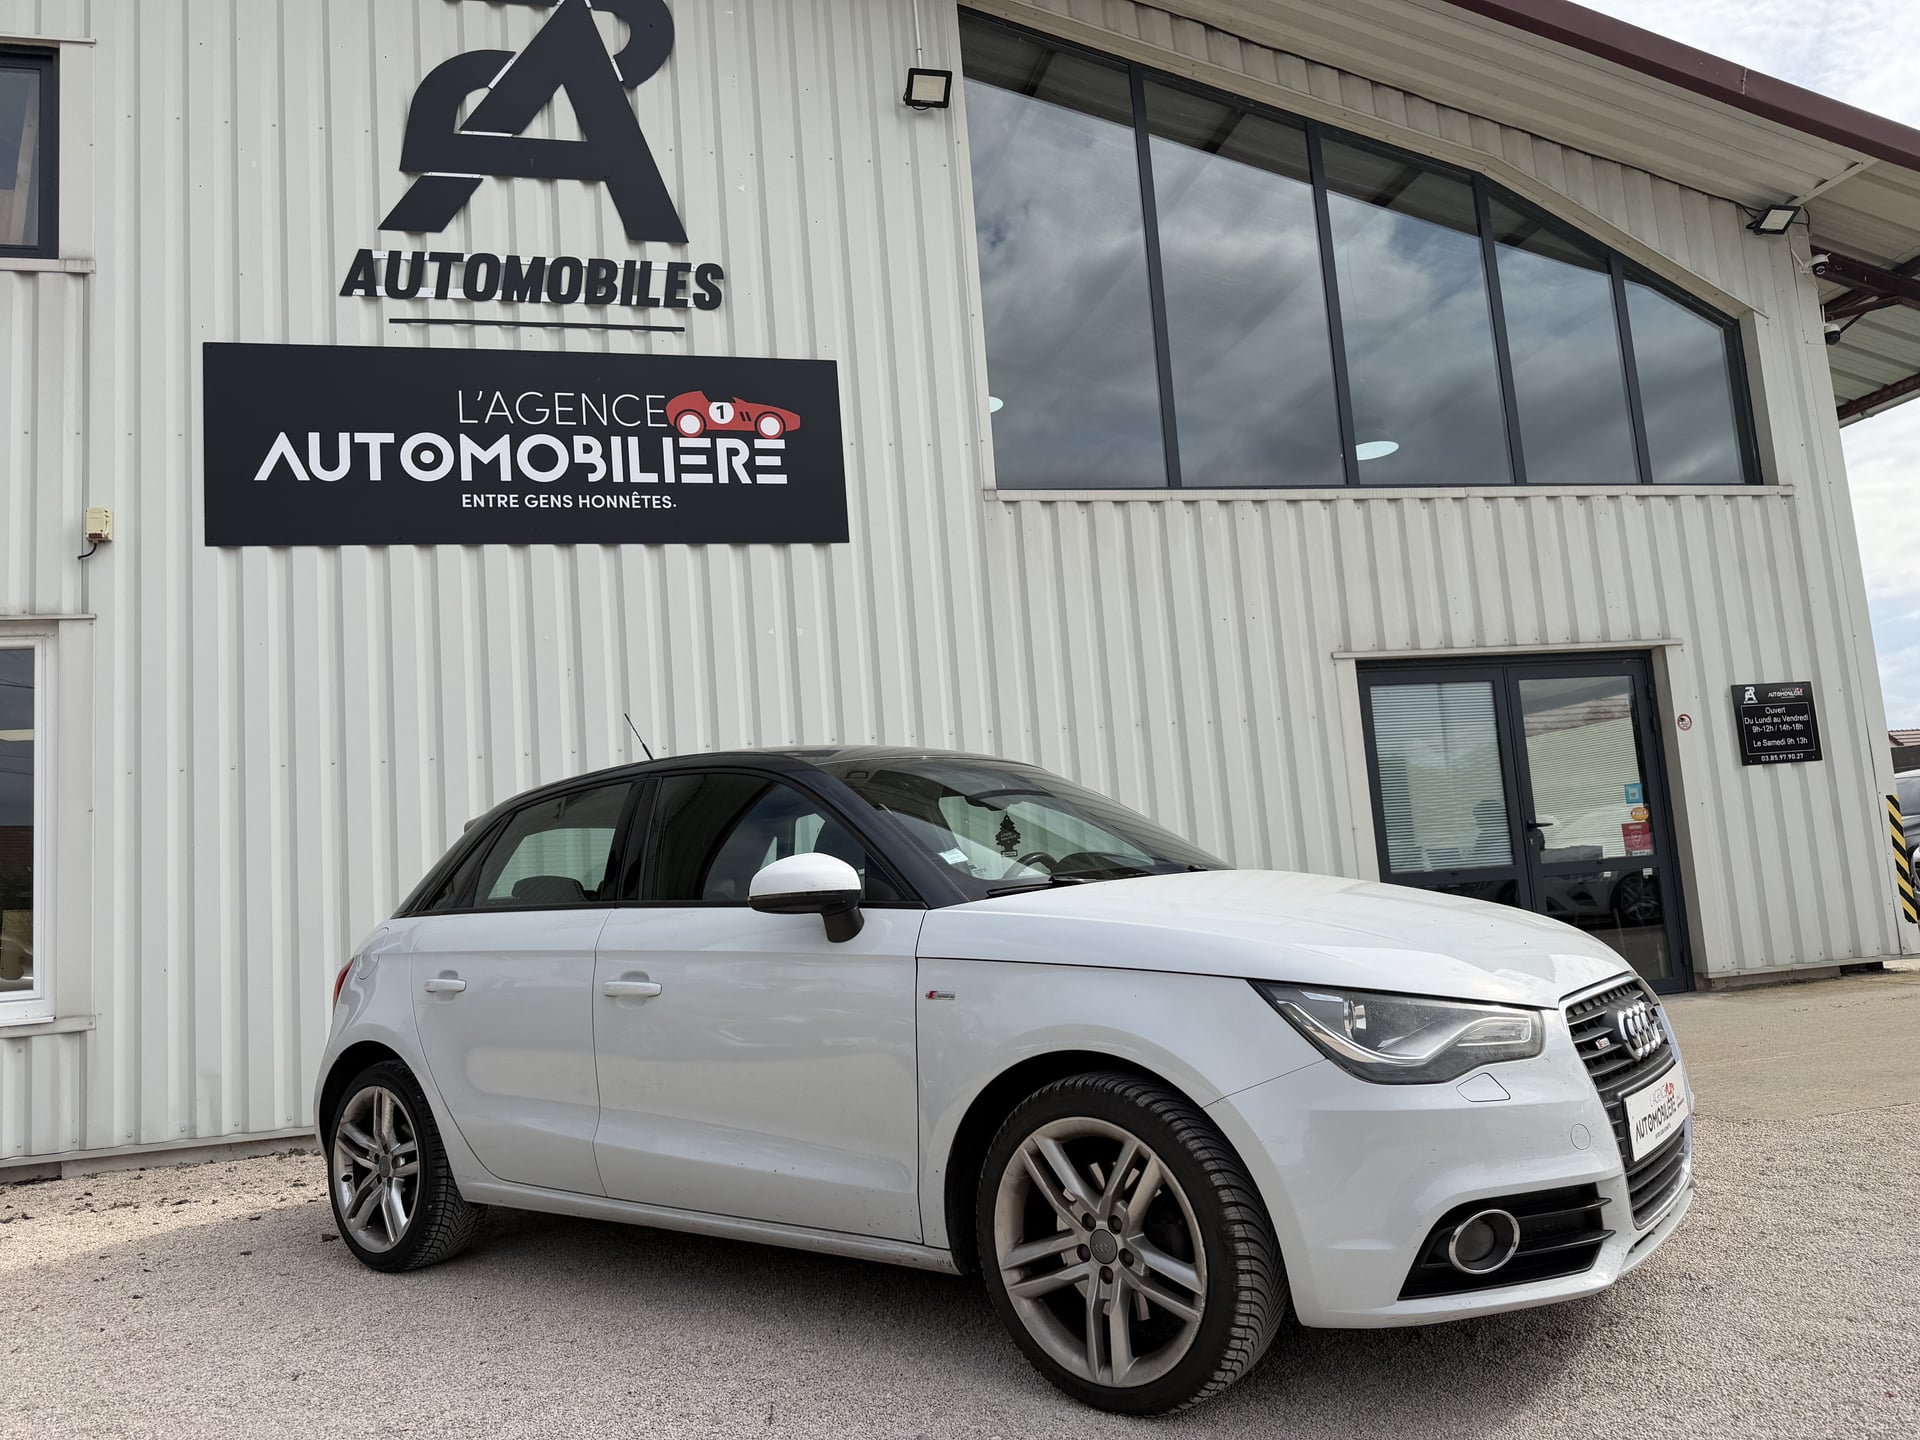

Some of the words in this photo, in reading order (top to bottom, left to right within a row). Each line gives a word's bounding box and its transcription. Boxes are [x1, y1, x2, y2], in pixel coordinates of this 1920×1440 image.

[339, 248, 724, 311] AUTOMOBILES
[458, 389, 668, 428] L'AGENCE
[461, 494, 519, 509] ENTRE
[524, 494, 573, 509] GENS
[578, 491, 677, 510] HONNÊTES.
[1765, 706, 1786, 714] Ouvert
[1744, 717, 1754, 725] Du
[1755, 715, 1772, 724] Lundi
[1782, 713, 1808, 722] Vendredi
[1753, 740, 1762, 748] Le
[1762, 738, 1786, 747] Samedi
[1796, 736, 1808, 745] 13h
